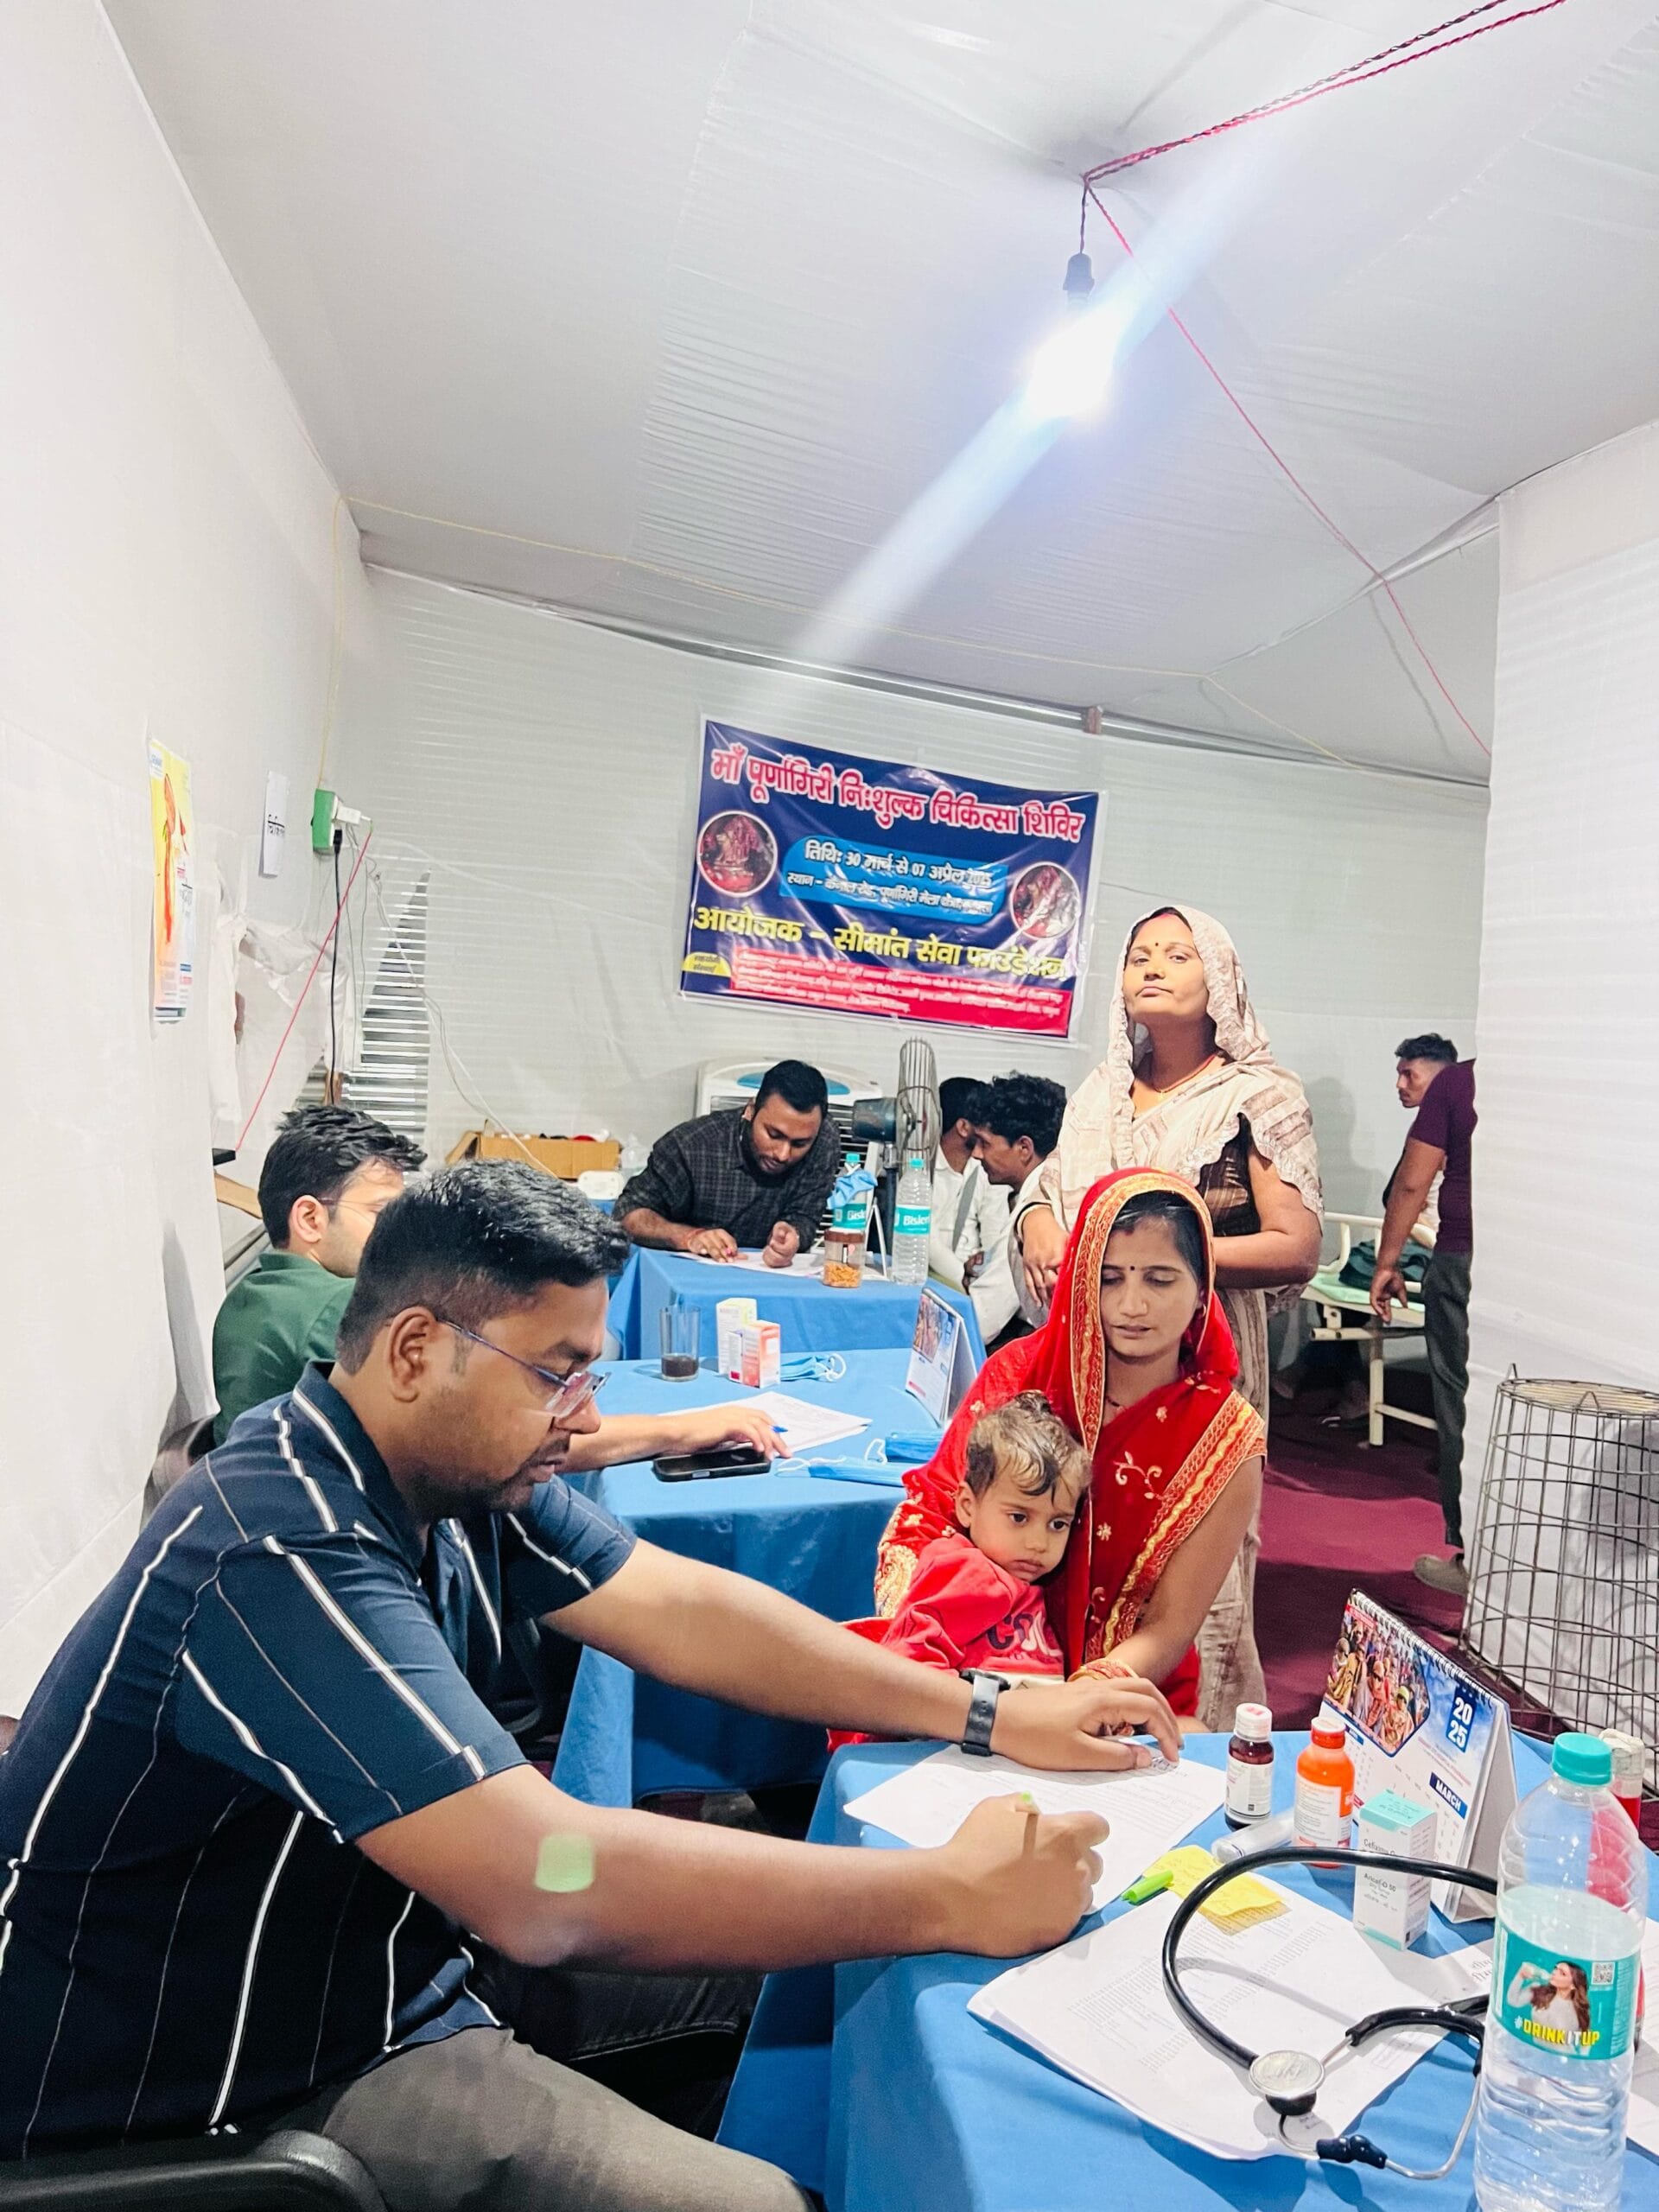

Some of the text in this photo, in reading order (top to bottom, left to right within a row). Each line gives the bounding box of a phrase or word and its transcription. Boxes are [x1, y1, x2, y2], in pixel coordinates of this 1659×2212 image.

[711, 742, 748, 785] माँ
[838, 768, 929, 830] निःशुल्क
[930, 789, 1020, 835] चिकित्सा
[1022, 799, 1086, 843] शिविर
[787, 872, 814, 887] स्थान
[895, 856, 910, 875] से
[912, 863, 925, 878] 07
[693, 904, 804, 943] आयोजक
[834, 921, 911, 959] सीमांत
[916, 933, 963, 966] सेवा
[1452, 1696, 1473, 1726] 20
[1448, 1719, 1468, 1748] 25
[1435, 1780, 1462, 1812] MARCH
